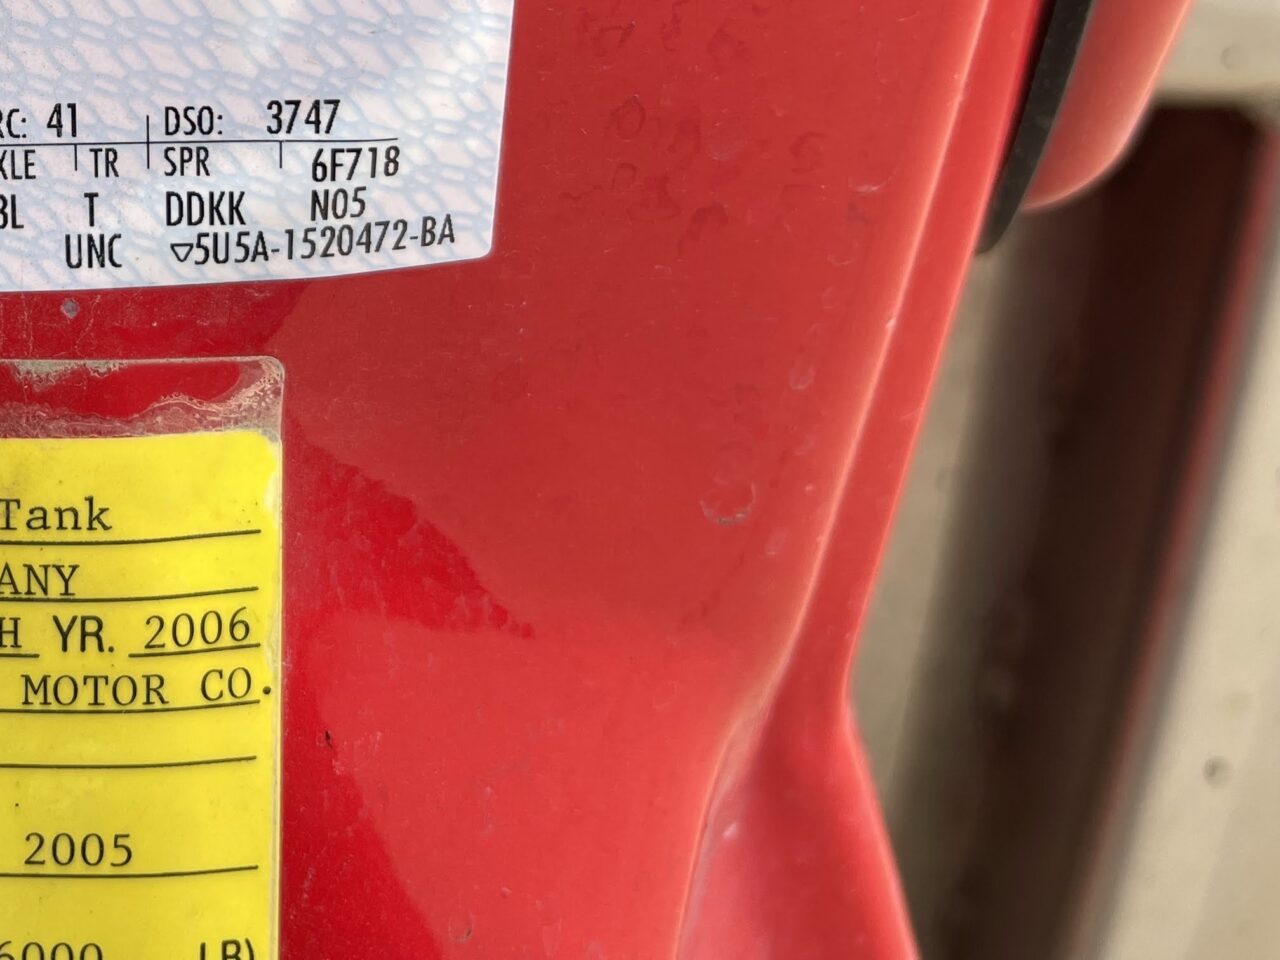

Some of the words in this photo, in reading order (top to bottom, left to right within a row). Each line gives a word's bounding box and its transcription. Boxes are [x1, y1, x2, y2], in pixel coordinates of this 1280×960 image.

[46, 102, 79, 138] 41
[163, 105, 224, 137] DSO:
[265, 99, 341, 136] 3747
[89, 148, 120, 179] TR
[163, 146, 211, 178] SPR
[310, 146, 401, 183] 6F718
[83, 192, 100, 228] T
[165, 191, 247, 227] DDKK
[64, 234, 123, 269] UNC
[193, 214, 456, 266] 5U5A-1520472-BA
[52, 614, 116, 655] YR.
[143, 606, 251, 650] 2006
[21, 674, 170, 707] MOTOR
[200, 666, 272, 703] CO.
[23, 832, 134, 868] 2005
